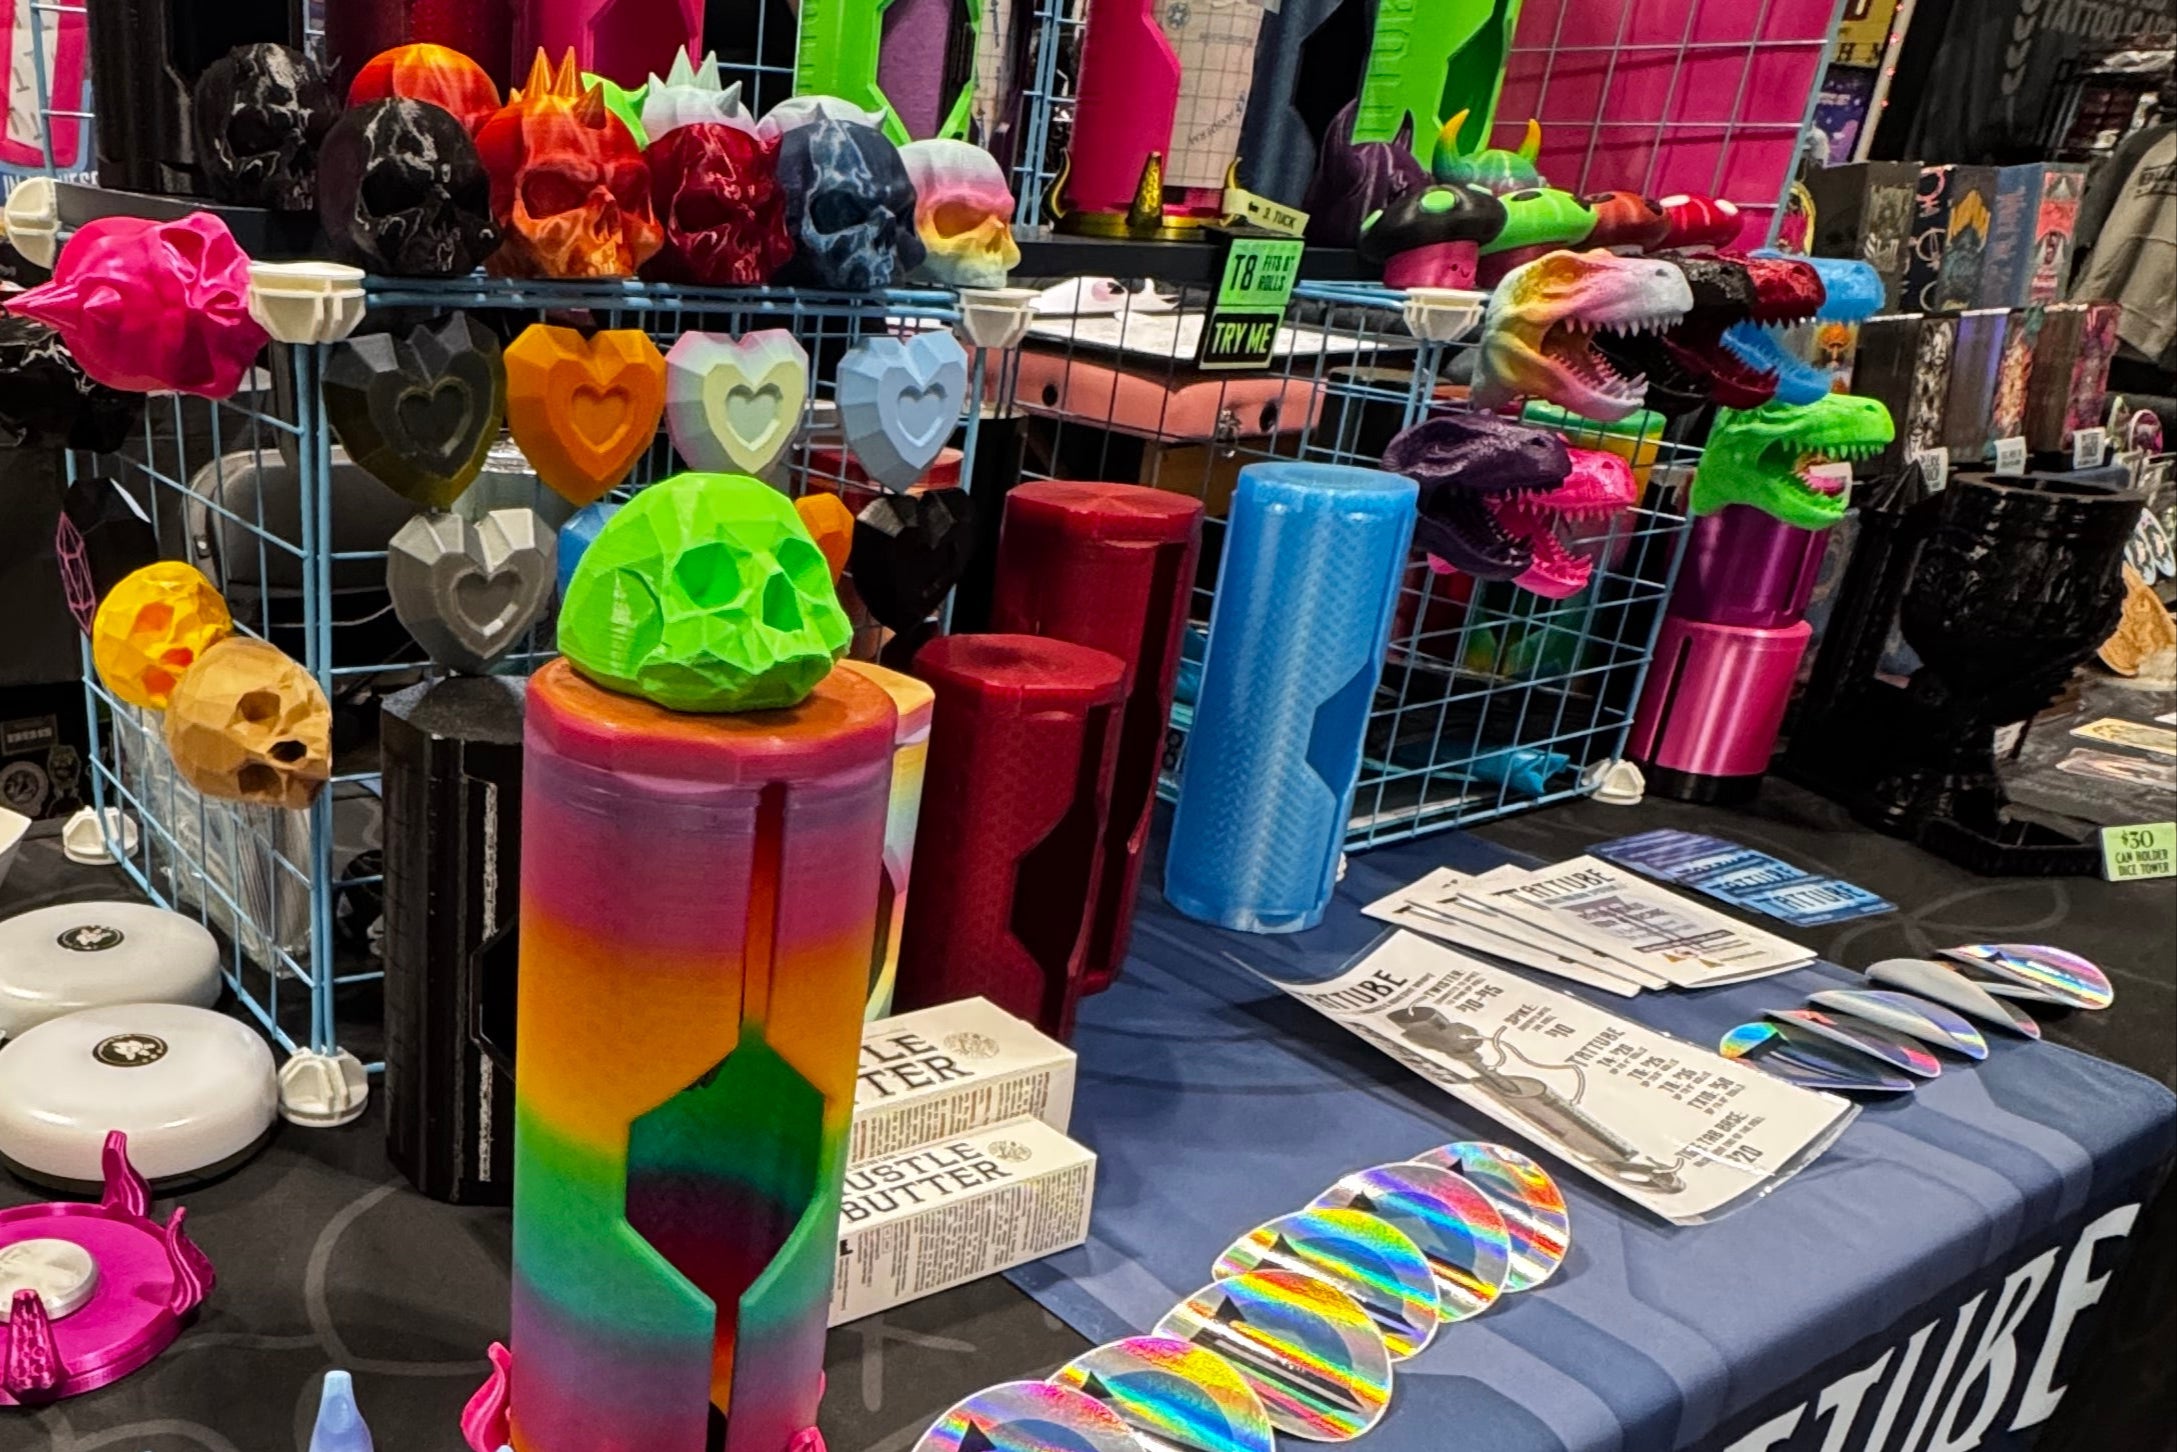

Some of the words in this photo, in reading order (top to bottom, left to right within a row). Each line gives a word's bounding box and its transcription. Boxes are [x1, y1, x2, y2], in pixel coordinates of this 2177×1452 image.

[1230, 254, 1258, 291] T8
[1211, 322, 1247, 355] TRY
[1245, 322, 1274, 354] ME
[2115, 851, 2133, 864] CAN
[2136, 849, 2169, 862] HOLDER
[2121, 829, 2154, 849] $30
[2118, 863, 2138, 877] DICE
[2140, 861, 2170, 875] TOWER
[1490, 868, 1616, 911] TATTUBE
[1564, 1026, 1627, 1068] TATTUBE
[843, 1142, 984, 1195] USTLE
[842, 1160, 1013, 1224] BUTTER
[1722, 1202, 2142, 1452] TUBE
